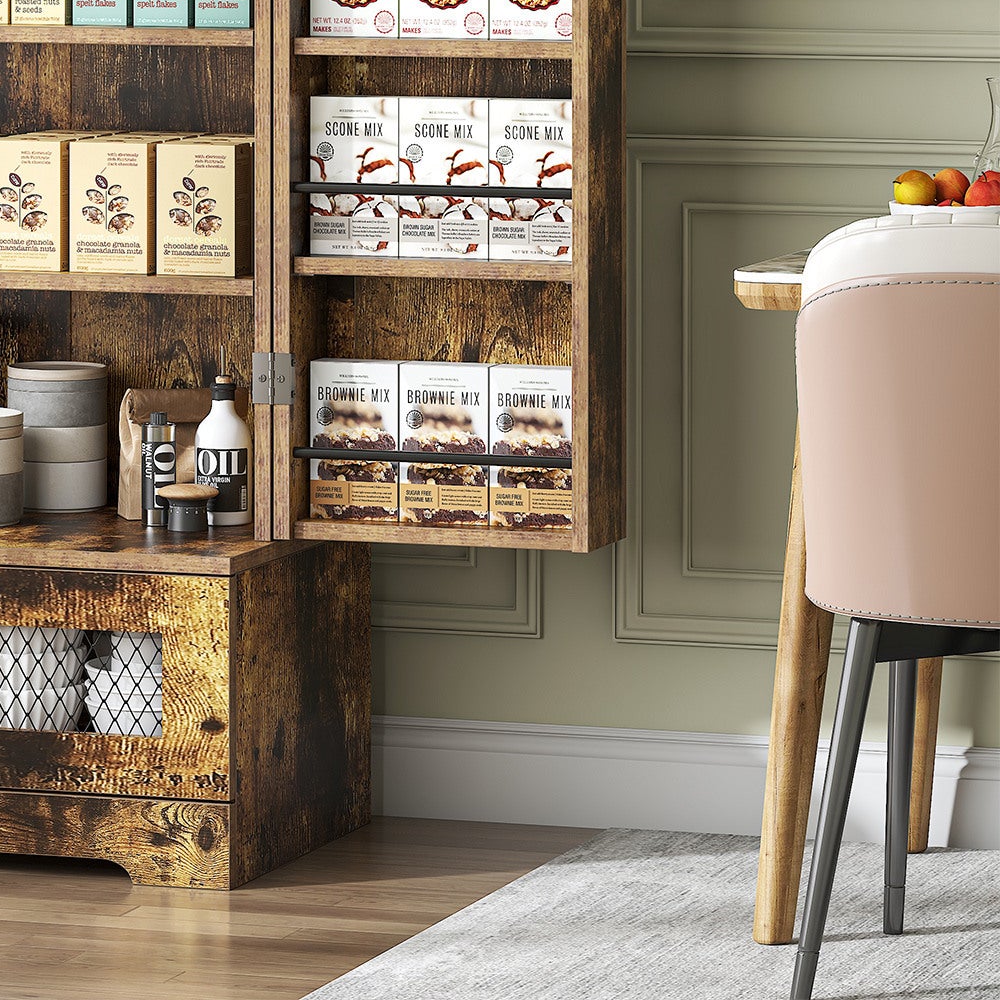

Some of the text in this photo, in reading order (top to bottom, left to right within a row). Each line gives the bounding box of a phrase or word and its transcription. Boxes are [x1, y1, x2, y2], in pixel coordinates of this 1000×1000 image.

[76, 0, 94, 8] spelt
[325, 122, 383, 137] SCONE MIX
[415, 124, 473, 138] SCONE MIX
[505, 126, 563, 140] SCONE MIX
[200, 244, 229, 252] granola
[317, 386, 390, 402] BROWNIE MIX
[407, 389, 480, 406] BROWNIE MIX
[498, 393, 571, 409] BROWNIE MIX
[145, 443, 153, 479] WALNUT
[198, 450, 246, 475] OIL
